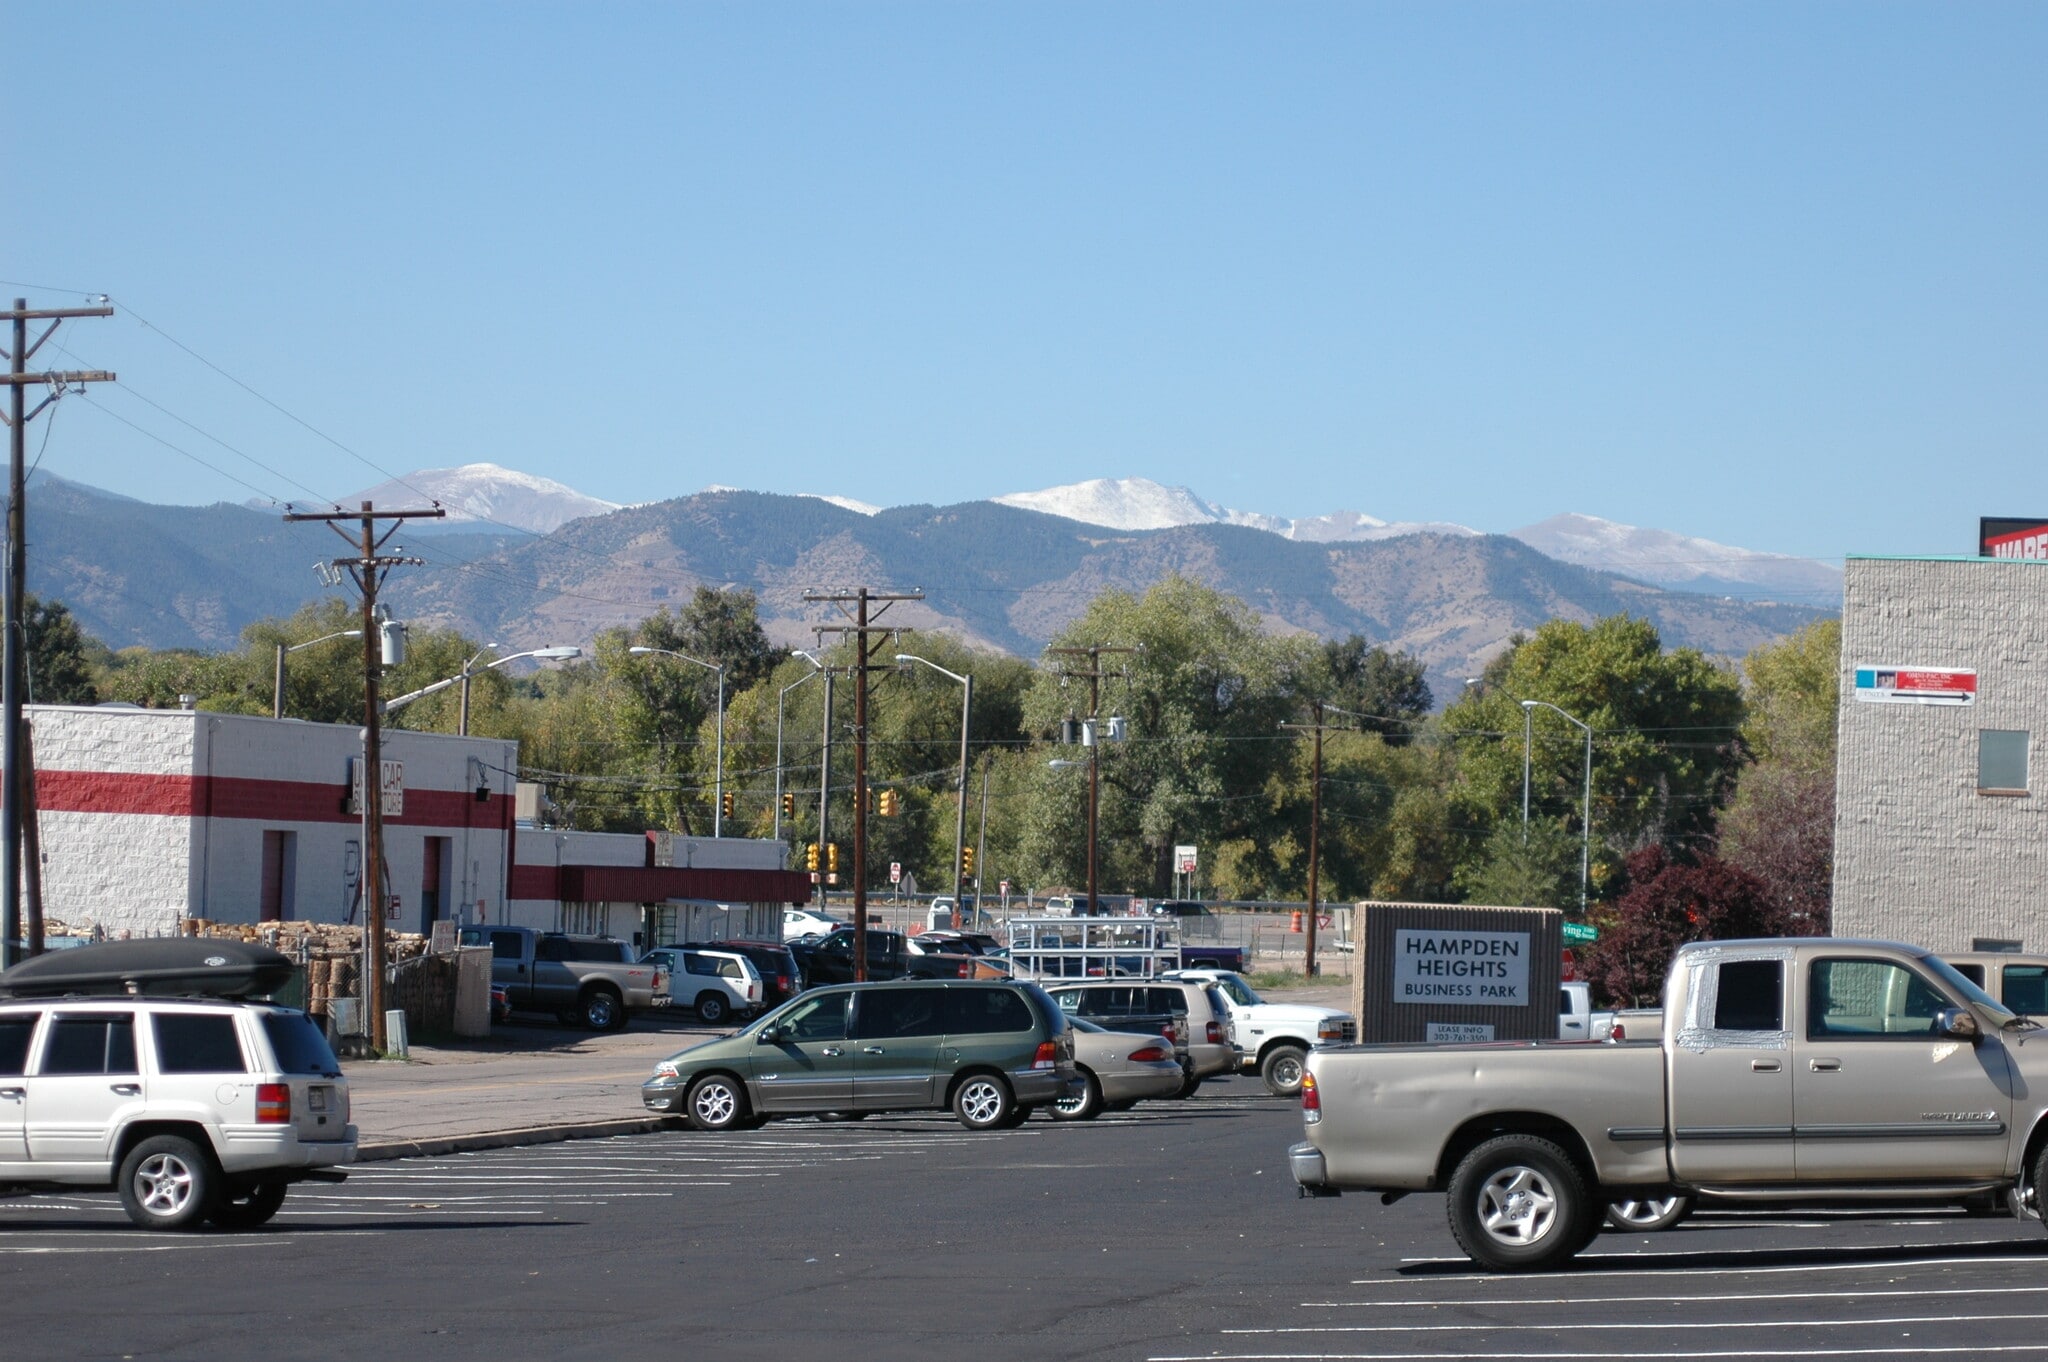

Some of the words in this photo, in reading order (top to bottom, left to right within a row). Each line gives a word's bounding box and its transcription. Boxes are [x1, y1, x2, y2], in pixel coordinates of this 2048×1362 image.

[383, 763, 403, 789] CAR
[1563, 923, 1581, 938] ving
[1406, 938, 1519, 957] HAMPDEN
[1417, 960, 1507, 978] HEIGHTS
[1562, 961, 1574, 977] TOP
[1405, 983, 1472, 996] BUSINESS
[1480, 985, 1517, 998] PARK
